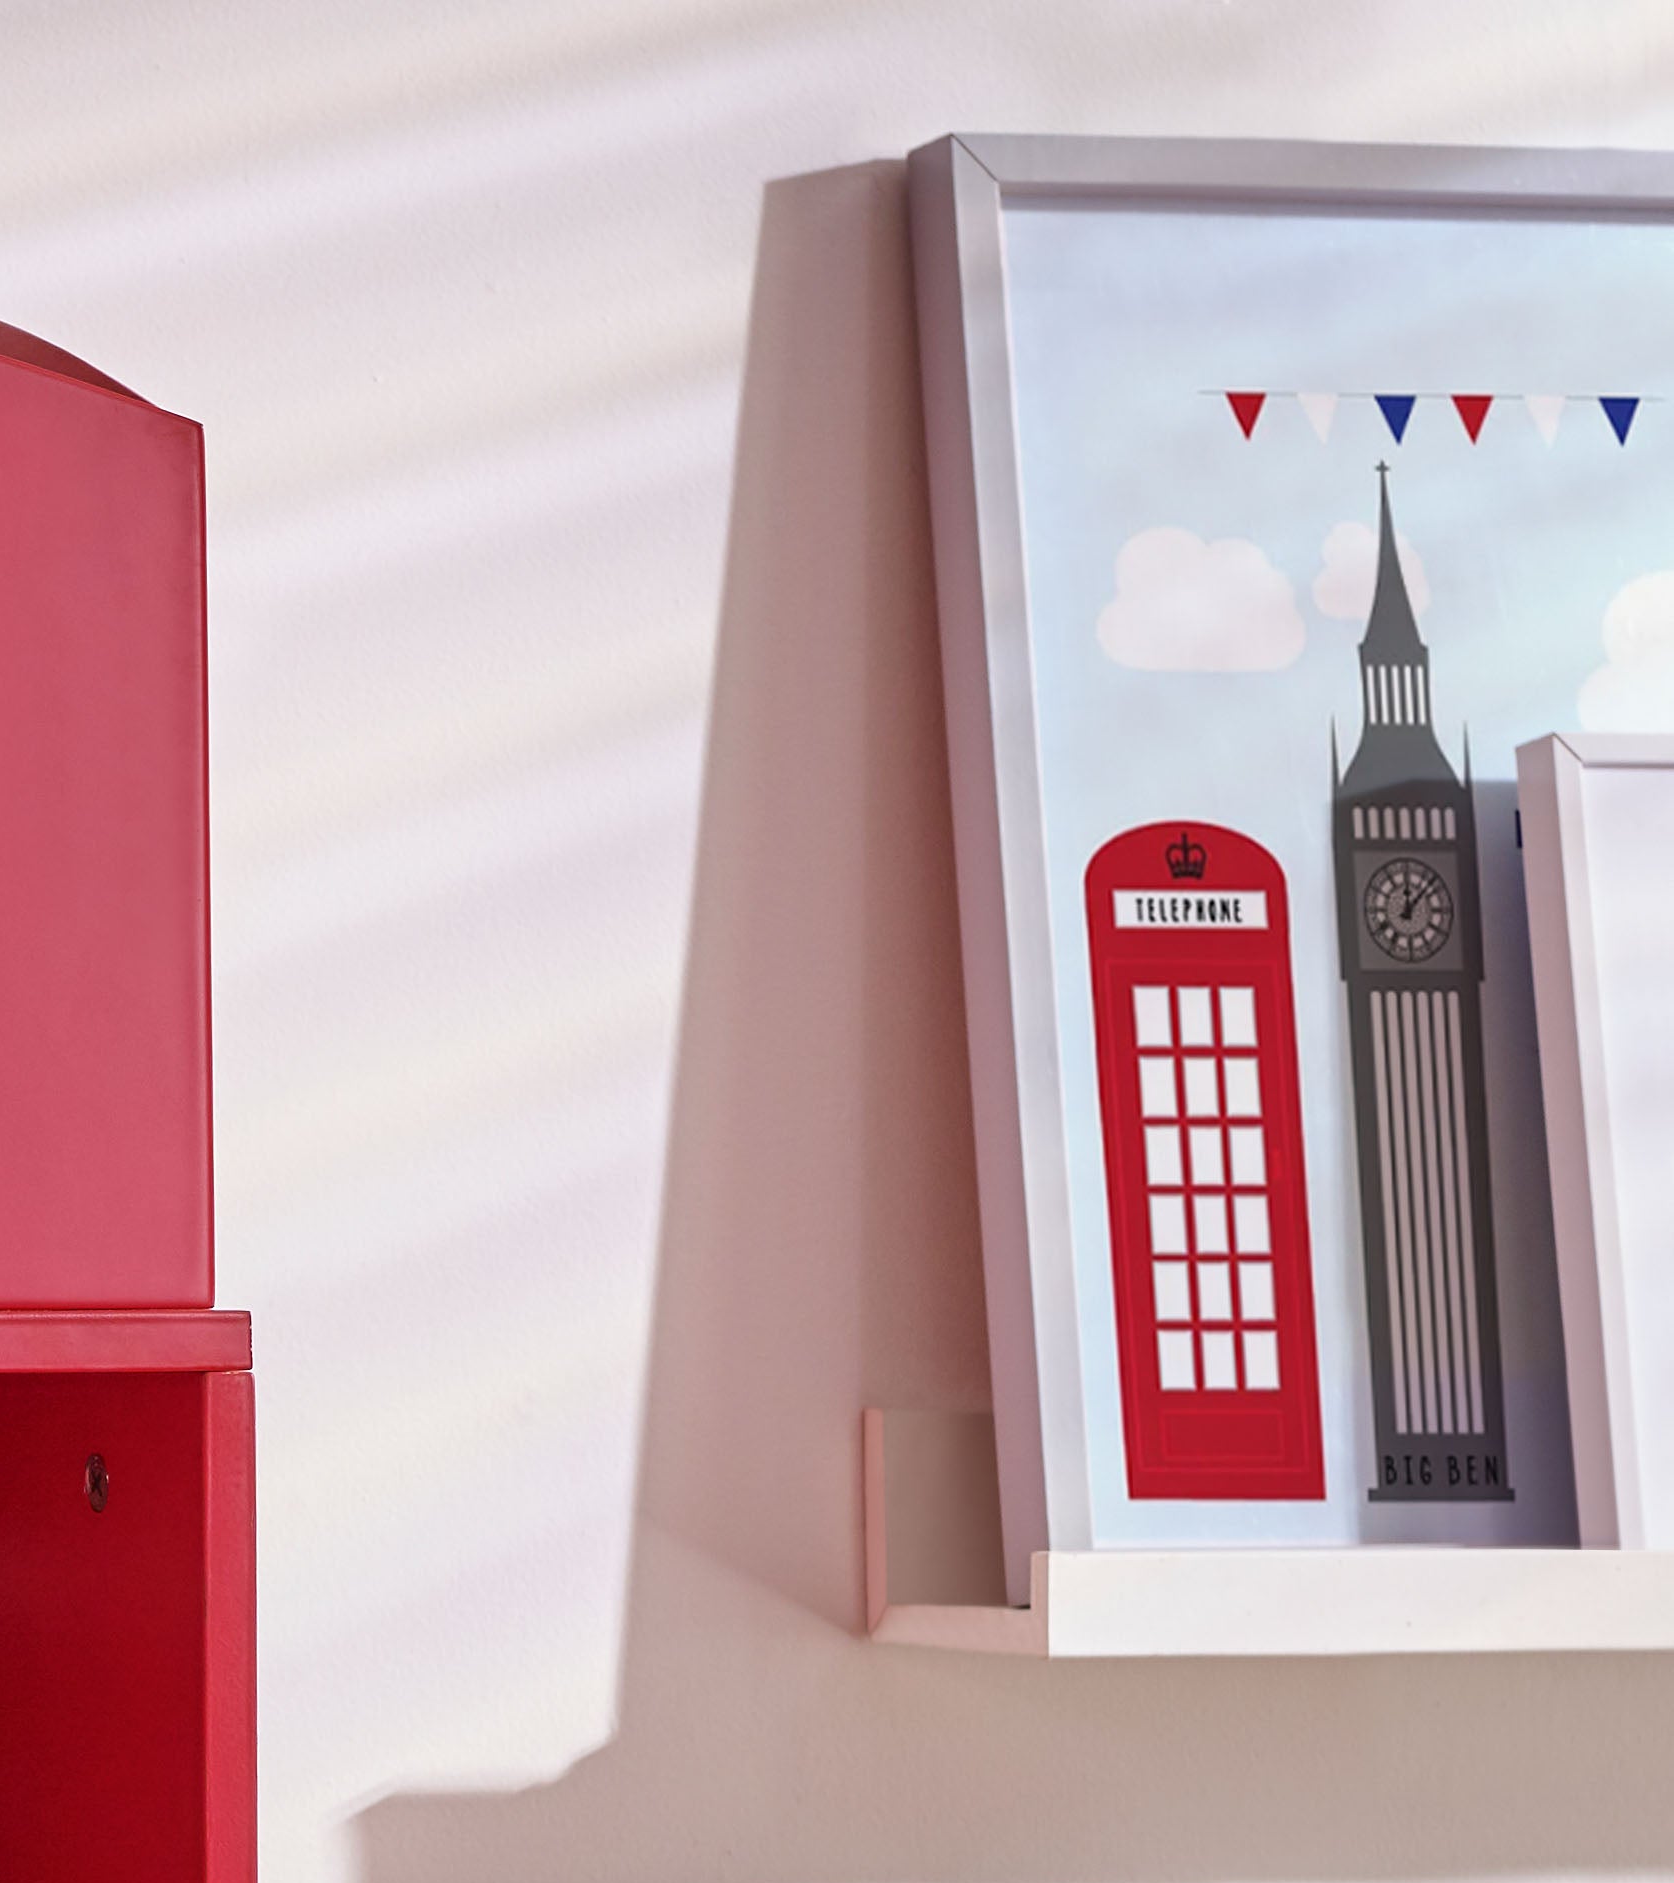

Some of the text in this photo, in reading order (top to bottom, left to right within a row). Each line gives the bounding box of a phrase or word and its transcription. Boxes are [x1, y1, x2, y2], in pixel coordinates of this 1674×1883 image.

[1135, 897, 1243, 924] TELEPHONE
[1383, 1455, 1500, 1486] BIG BEN
